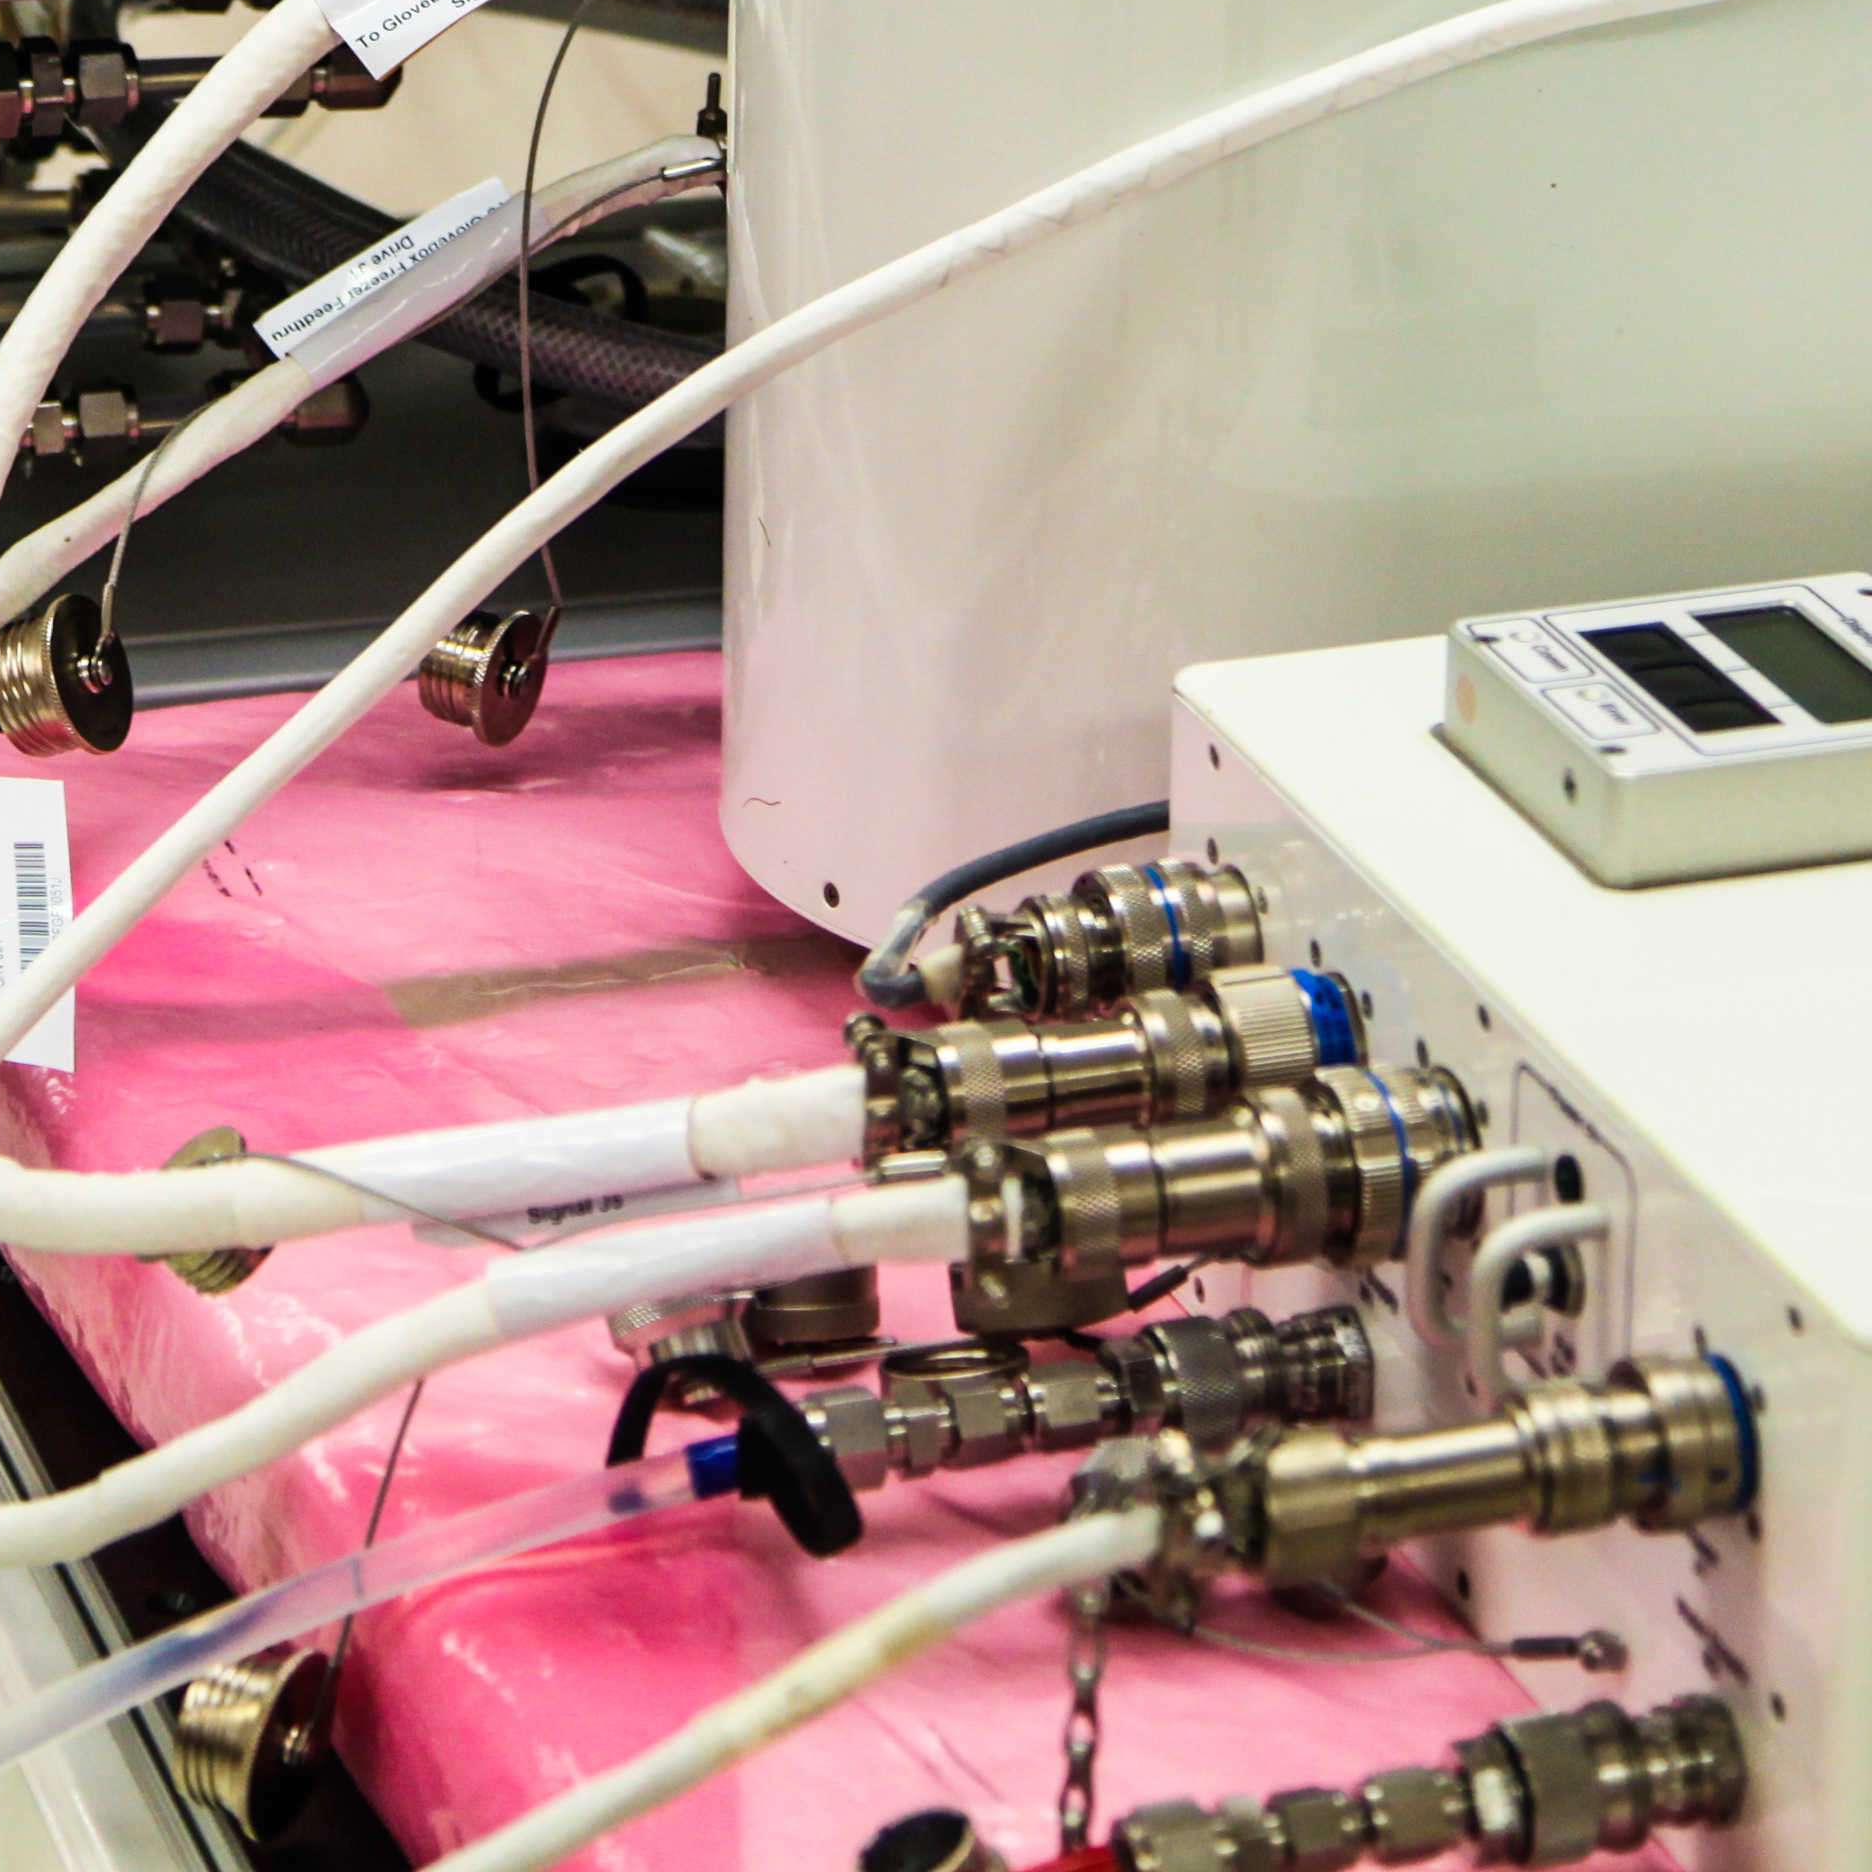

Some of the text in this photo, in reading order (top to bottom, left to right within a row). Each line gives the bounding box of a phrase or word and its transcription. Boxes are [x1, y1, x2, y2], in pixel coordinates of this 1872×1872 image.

[355, 31, 380, 49] To
[371, 235, 415, 264] Drive
[271, 296, 346, 342] Feedthru
